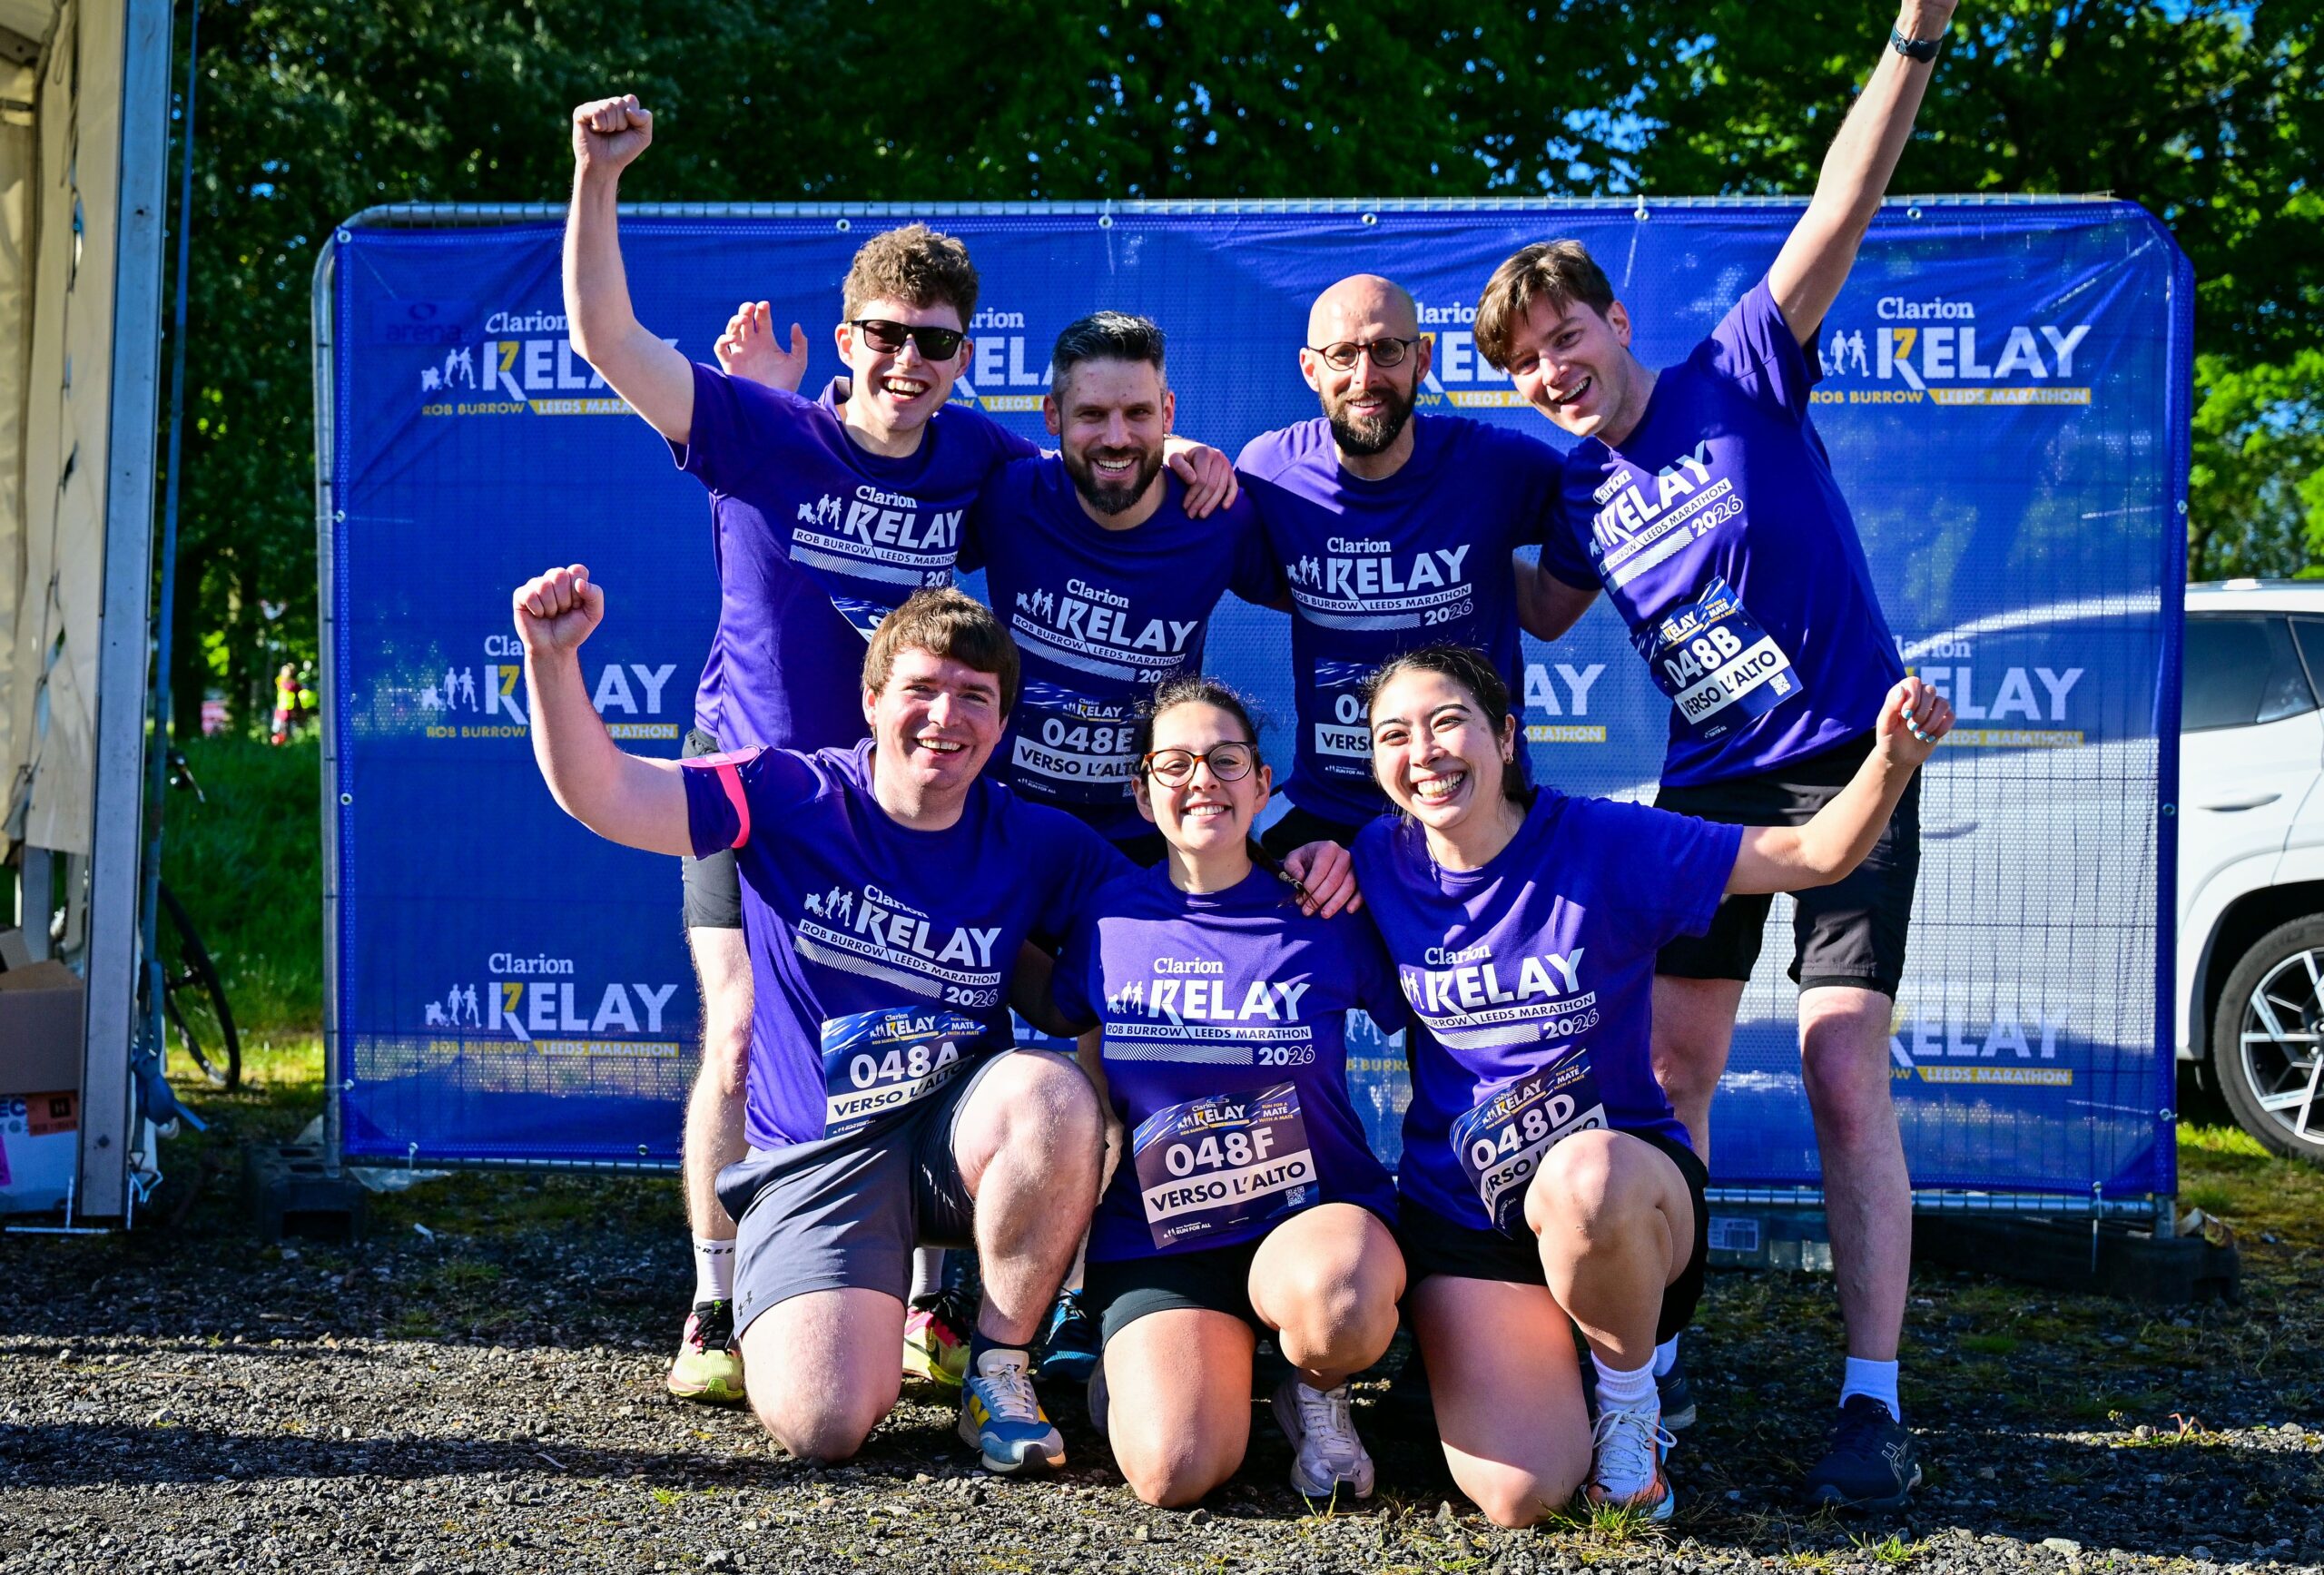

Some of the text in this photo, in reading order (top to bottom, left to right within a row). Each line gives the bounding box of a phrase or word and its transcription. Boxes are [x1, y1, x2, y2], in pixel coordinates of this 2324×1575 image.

[970, 307, 1025, 329] rion
[1415, 301, 1478, 324] lario
[1876, 297, 1975, 320] Clarion
[486, 310, 567, 333] Clarion
[1876, 325, 2092, 390] RELAY
[482, 339, 679, 401] REL
[422, 399, 635, 416] ROB BURROW LEEDS MARA
[990, 399, 1033, 409] LEEDS
[1458, 393, 1502, 406] LEEDS
[1810, 389, 2087, 404] ROB BURROW LEEDS MARATHON
[856, 485, 918, 508] Clarion
[1601, 439, 1710, 545] RELAY
[843, 500, 963, 549] RELAY
[1643, 522, 1669, 543] LEEDS
[1669, 482, 1728, 526] MARATHON
[1692, 494, 1744, 537] 2026
[796, 531, 958, 565] ROB BURROW LEEDS MARATHO
[1326, 537, 1391, 553] Clarion
[925, 568, 951, 586] 20
[1326, 545, 1471, 600] RELAY
[1067, 578, 1129, 608] Clarion
[1294, 586, 1469, 610] ROB BURROW LEEDS MARATHON
[1424, 598, 1473, 625] 2026
[1056, 596, 1198, 652] RELAY
[1015, 616, 1184, 665] ROB BURROW LEEDS MARATHON
[1894, 635, 1971, 658] larion
[1664, 625, 1742, 689] 048B
[485, 664, 677, 724] RAY
[1681, 651, 1777, 717] VERSO L'ALTO
[1906, 666, 2083, 720] LAY
[1077, 704, 1123, 718] RELAY
[427, 726, 527, 738] ROB BURROW
[608, 726, 675, 738] RATHON
[1042, 718, 1135, 753] 048E
[1321, 732, 1374, 752] VERS
[1532, 727, 1601, 741] RATHON
[1945, 731, 2079, 745] EEDS MARATHON
[1020, 746, 1081, 775] VERSO
[863, 884, 929, 919] Clarion
[854, 899, 1002, 968] RELAY
[488, 953, 574, 974] Clarion
[803, 922, 998, 984] ROB BURROW LEEDS MARATHON
[1425, 945, 1492, 965] Clarion
[1154, 957, 1224, 974] Clarion
[1424, 948, 1585, 1015] RELAY
[944, 987, 999, 1008] 2026
[1148, 979, 1311, 1026] RELAY
[488, 982, 679, 1041] RELAY
[885, 1012, 908, 1021] Clarion
[1480, 1011, 1515, 1023] LEEDS
[1520, 997, 1593, 1018] MARATHON
[886, 1016, 936, 1038] RELAY
[951, 1021, 975, 1030] MATE
[1107, 1025, 1309, 1039] ROB BURROW LEEDS MARATHON
[1543, 1008, 1600, 1039] 2026
[464, 1041, 527, 1054] BURROW
[543, 1043, 584, 1055] LEEDS
[590, 1044, 675, 1057] MARATHON
[1258, 1044, 1315, 1066] 2026
[850, 1041, 959, 1088] 048A
[1557, 1068, 1580, 1084] MATE
[1927, 1067, 1972, 1082] LEEDS
[1977, 1069, 2068, 1084] MARATHON
[834, 1063, 965, 1117] VERSO L'ALTO
[1496, 1078, 1541, 1116] RELAY
[1192, 1103, 1216, 1112] Clarion
[1194, 1105, 1245, 1126] RELAY
[1263, 1107, 1288, 1117] MATE
[1472, 1094, 1575, 1171] 048D
[1165, 1127, 1274, 1176] 048F
[1150, 1161, 1306, 1212] VERSO L'ALTO
[1485, 1158, 1531, 1208] VERSO
